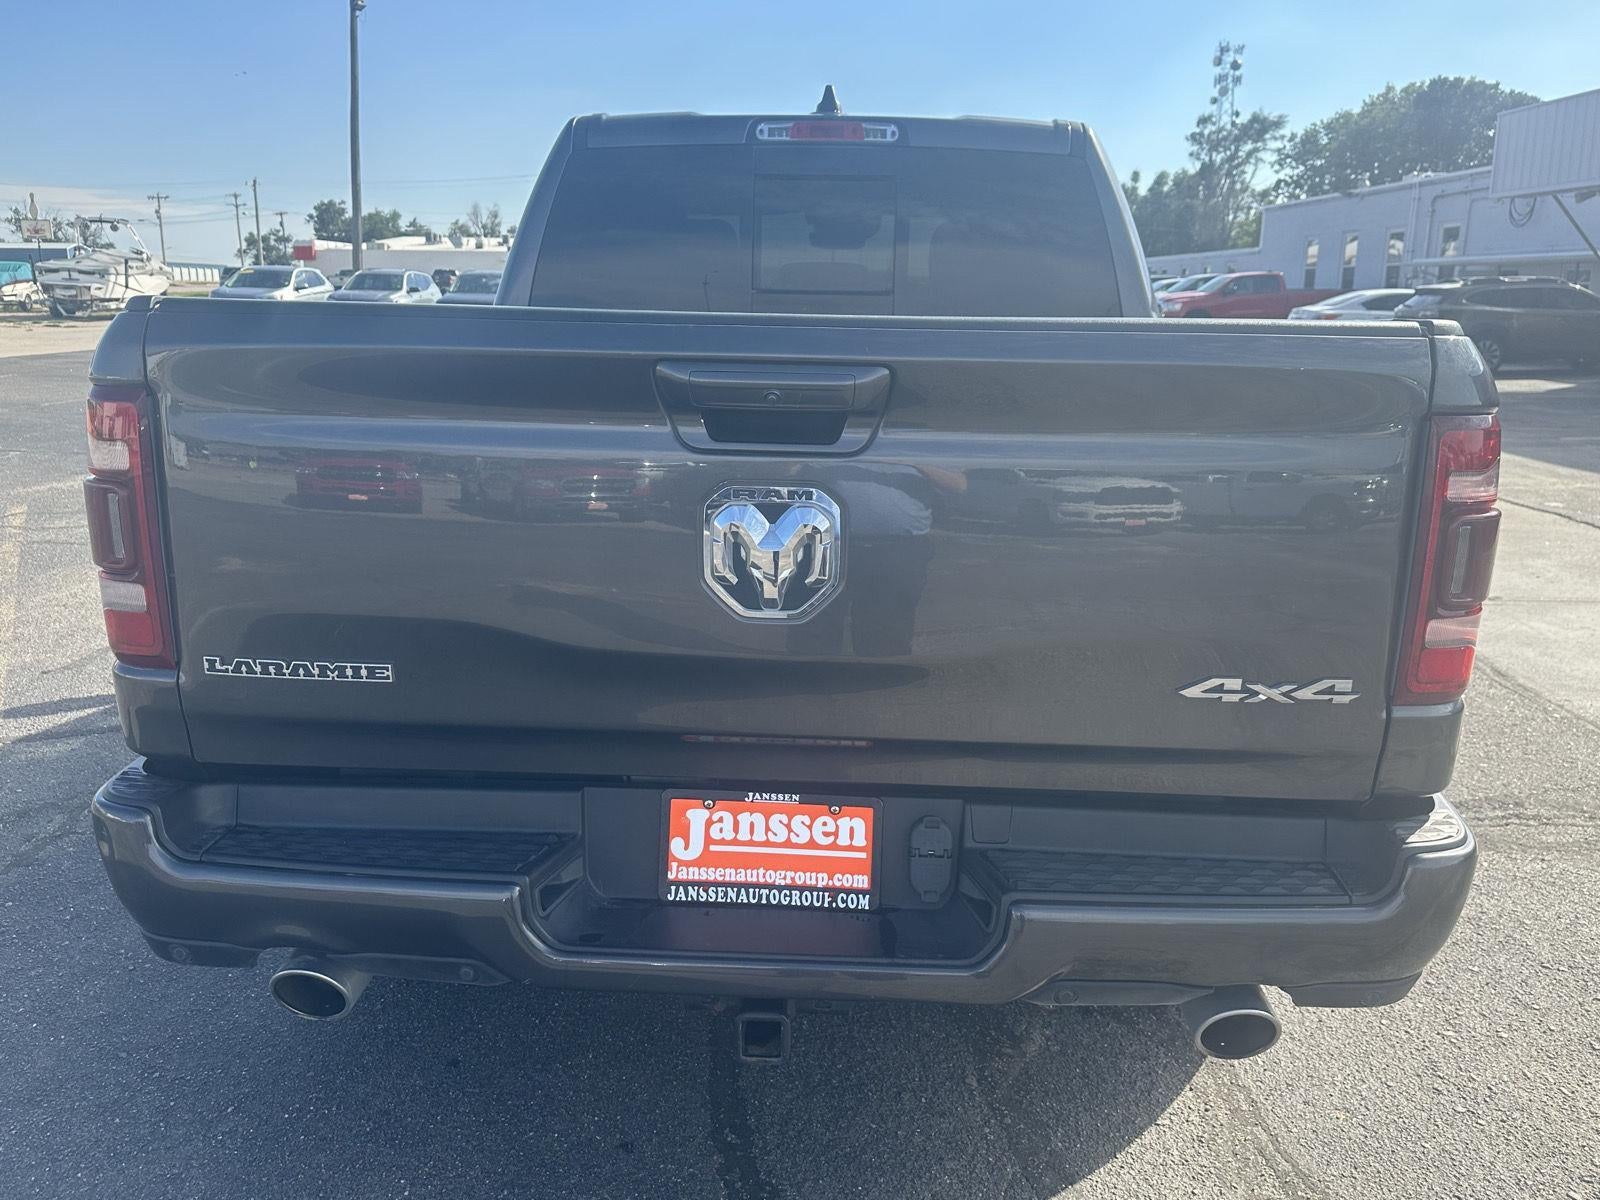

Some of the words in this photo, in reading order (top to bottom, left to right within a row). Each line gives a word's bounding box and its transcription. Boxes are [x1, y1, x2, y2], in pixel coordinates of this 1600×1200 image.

[731, 488, 815, 501] RAM
[203, 656, 393, 682] LARAMIE
[670, 808, 867, 861] Janssen
[667, 861, 869, 888] Janssenautogroup.com
